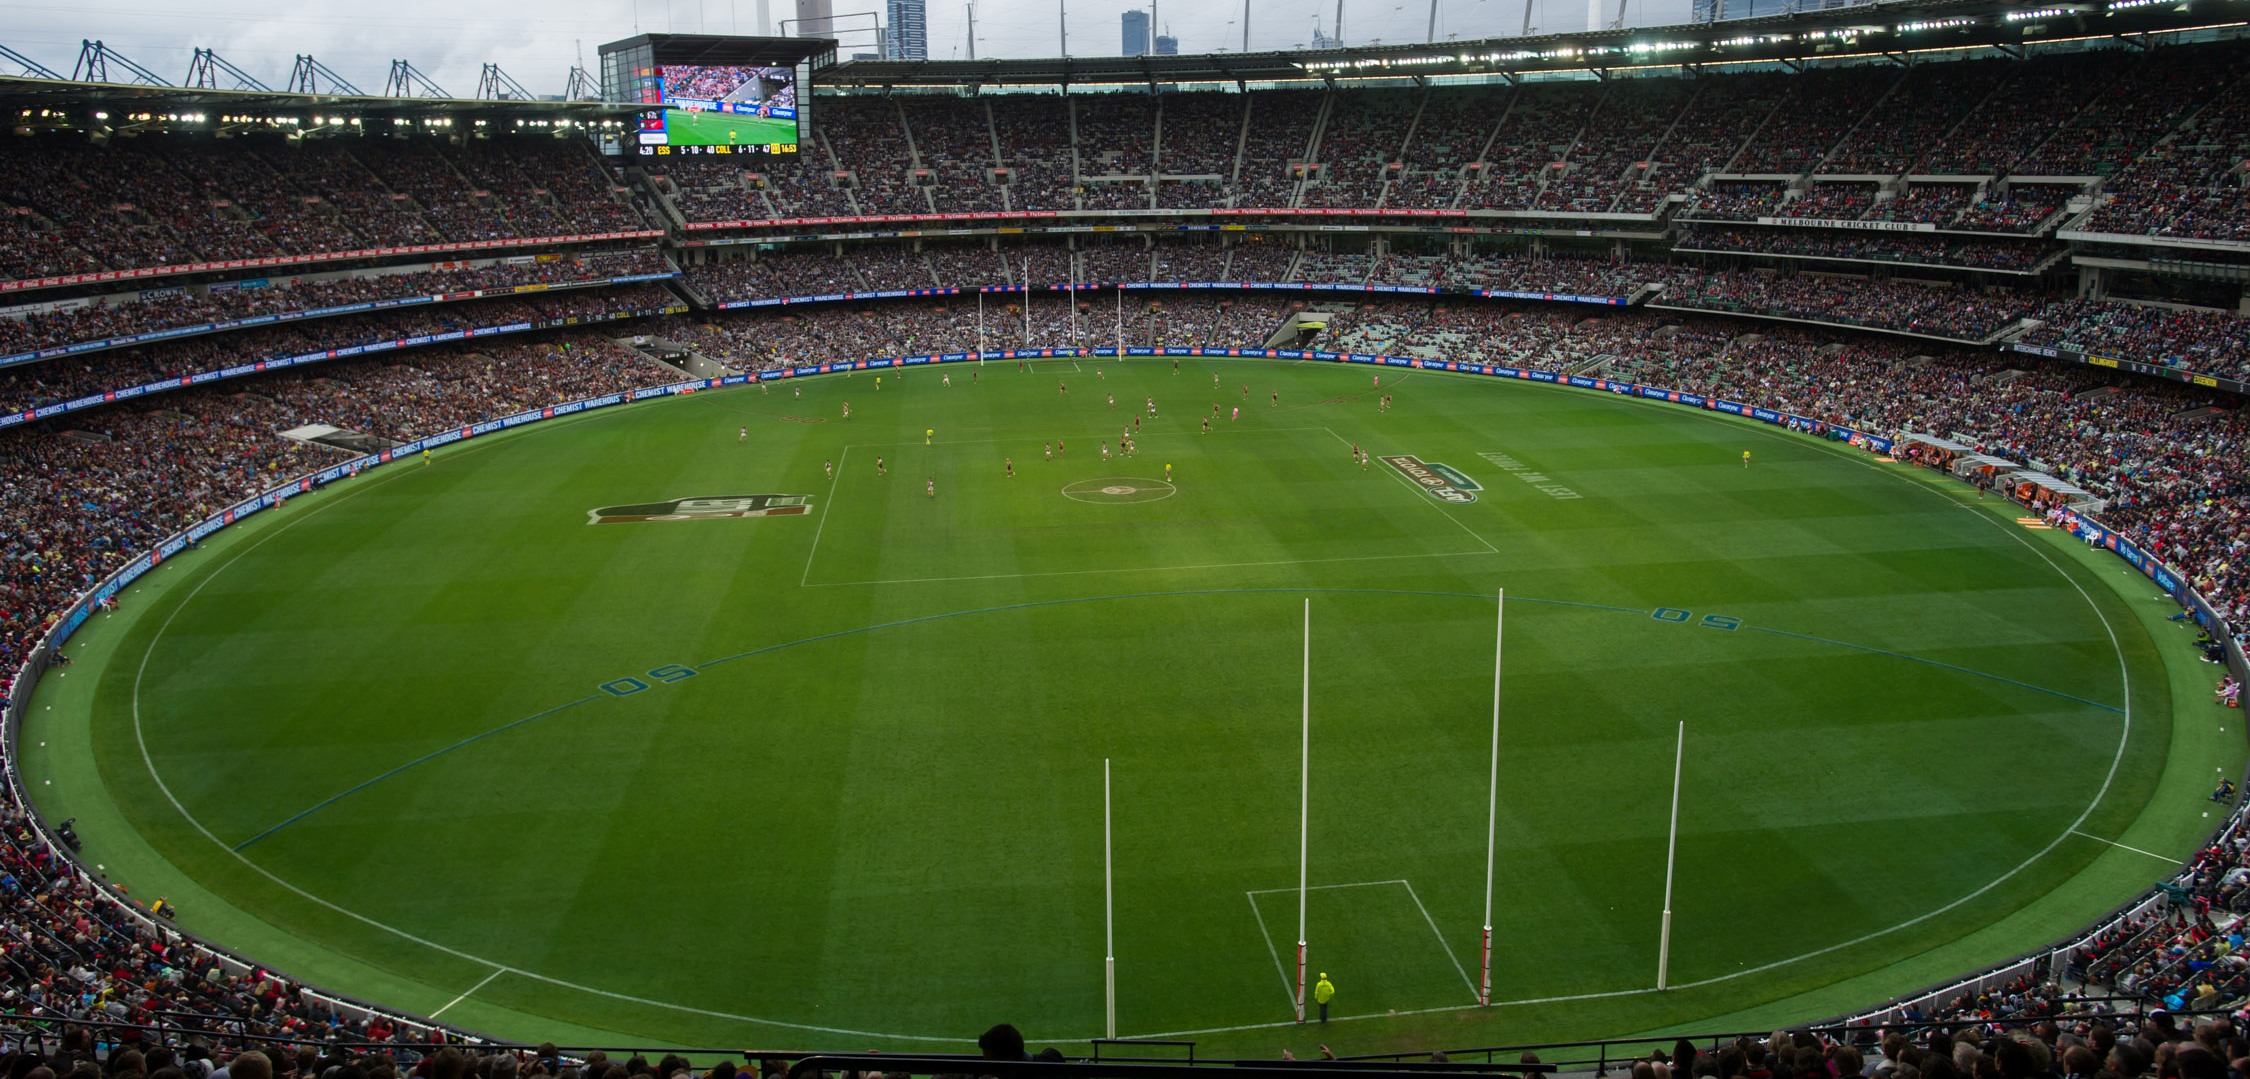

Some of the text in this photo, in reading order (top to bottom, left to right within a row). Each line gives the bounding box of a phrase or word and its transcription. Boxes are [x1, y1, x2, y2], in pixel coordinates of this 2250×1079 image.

[675, 100, 717, 110] WAREHOUSE
[640, 146, 653, 155] 4:20
[658, 146, 670, 154] ESS
[681, 146, 685, 154] 5
[691, 146, 699, 154] 10
[706, 146, 715, 154] 40
[716, 146, 731, 154] COLL
[763, 145, 770, 153] 47
[781, 144, 797, 153] 16:53
[1781, 218, 1836, 228] MELBOURNE
[1841, 221, 1880, 230] CRICKET
[147, 289, 177, 298] CROWN
[473, 323, 531, 336] CHEMIST WAREHOUSE
[406, 331, 464, 345] CHEMIST WAREHOUSE
[337, 340, 397, 356] CHEMIST WAREHOUSE
[2014, 345, 2057, 357] INTERCHANGE BENCH
[266, 351, 326, 368] CHEMIST WAREHOUSE
[1388, 356, 1407, 365] Claratyne
[2089, 356, 2118, 368] COLLINGWOOD
[192, 365, 255, 383] CHEMIST WAREHOUSE
[1532, 372, 1553, 380] Claratyne
[116, 379, 181, 399] CHEMIST WAREHOUSE
[636, 380, 706, 399] CHEMIST WAREHOUSE
[1645, 389, 1665, 398] Claratyne
[36, 394, 104, 418] CHEMIST WAREHOUSE
[554, 401, 583, 415] CHEMIST
[1718, 402, 1738, 411] Claratyne
[1755, 409, 1775, 419] Claratyne
[473, 412, 542, 434] CHEMIST WAREHOUSE
[392, 430, 461, 458] CHEMIST WAREHOUSE
[1392, 457, 1431, 477] TOYOTA
[1434, 486, 1470, 502] AFL
[234, 498, 261, 519] CHEMIST
[161, 534, 187, 558] CHEMIST
[118, 555, 151, 586] WAREHOUSE
